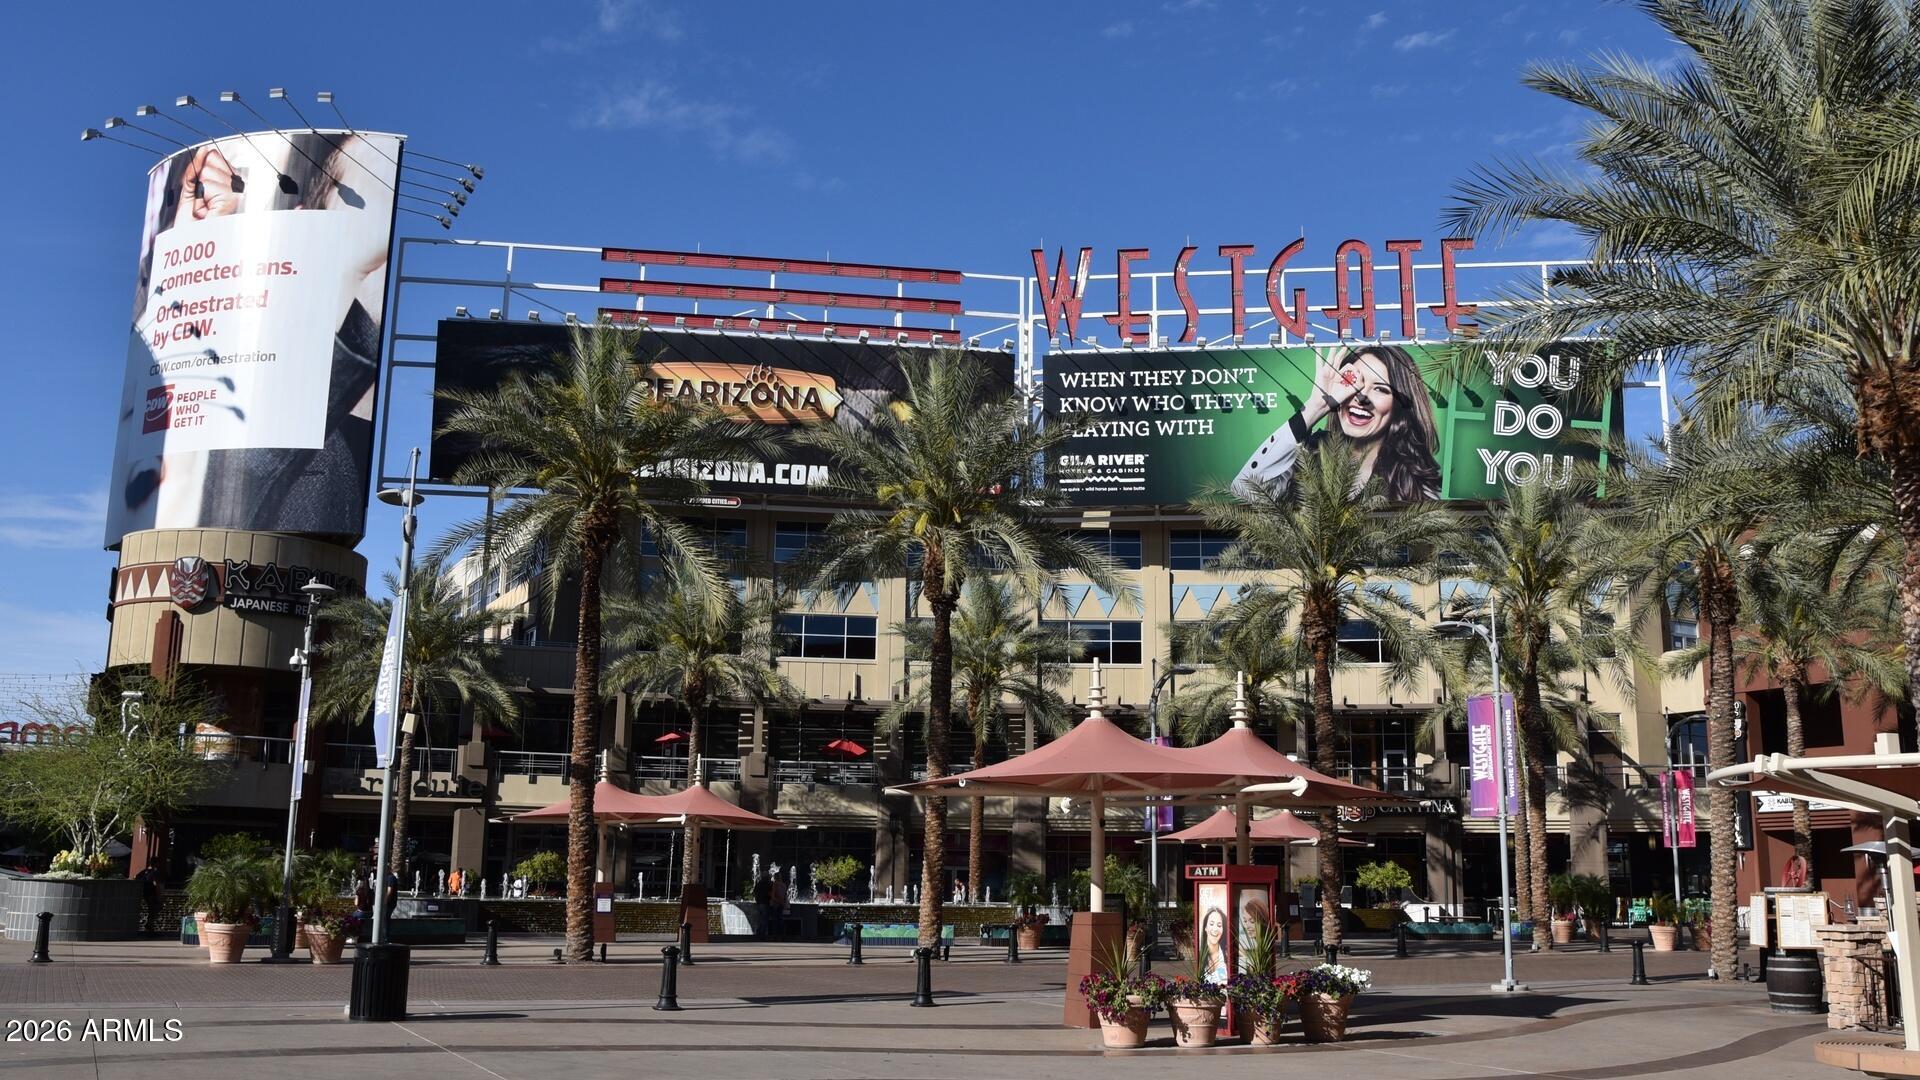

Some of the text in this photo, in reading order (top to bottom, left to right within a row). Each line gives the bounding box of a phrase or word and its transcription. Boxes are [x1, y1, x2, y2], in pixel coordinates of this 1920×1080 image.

[163, 240, 216, 270] 70,000
[160, 260, 298, 292] connected ans.
[156, 289, 269, 324] Orchestrated
[1030, 237, 1480, 347] WESTGATE
[152, 318, 217, 350] by CDW.
[149, 350, 276, 377] CDW.com/orchestration
[1059, 367, 1258, 389] WHEN THEY DON'T
[1484, 349, 1581, 391] YOU
[175, 403, 200, 416] WHO
[176, 389, 217, 404] PEOPLE
[637, 377, 824, 412] BEARIZONA
[1059, 392, 1278, 413] KNOW WHO THEY'RE
[174, 415, 205, 428] GET IT
[1155, 419, 1214, 436] WITH
[1493, 399, 1563, 439] DO
[1059, 454, 1096, 466] GILA
[1476, 448, 1574, 489] YOU
[229, 596, 290, 613] JAPANESE
[1471, 724, 1489, 782] WESTGATE
[1504, 708, 1516, 799] WHERE FUN HAPPENS
[1194, 866, 1219, 876] ATM
